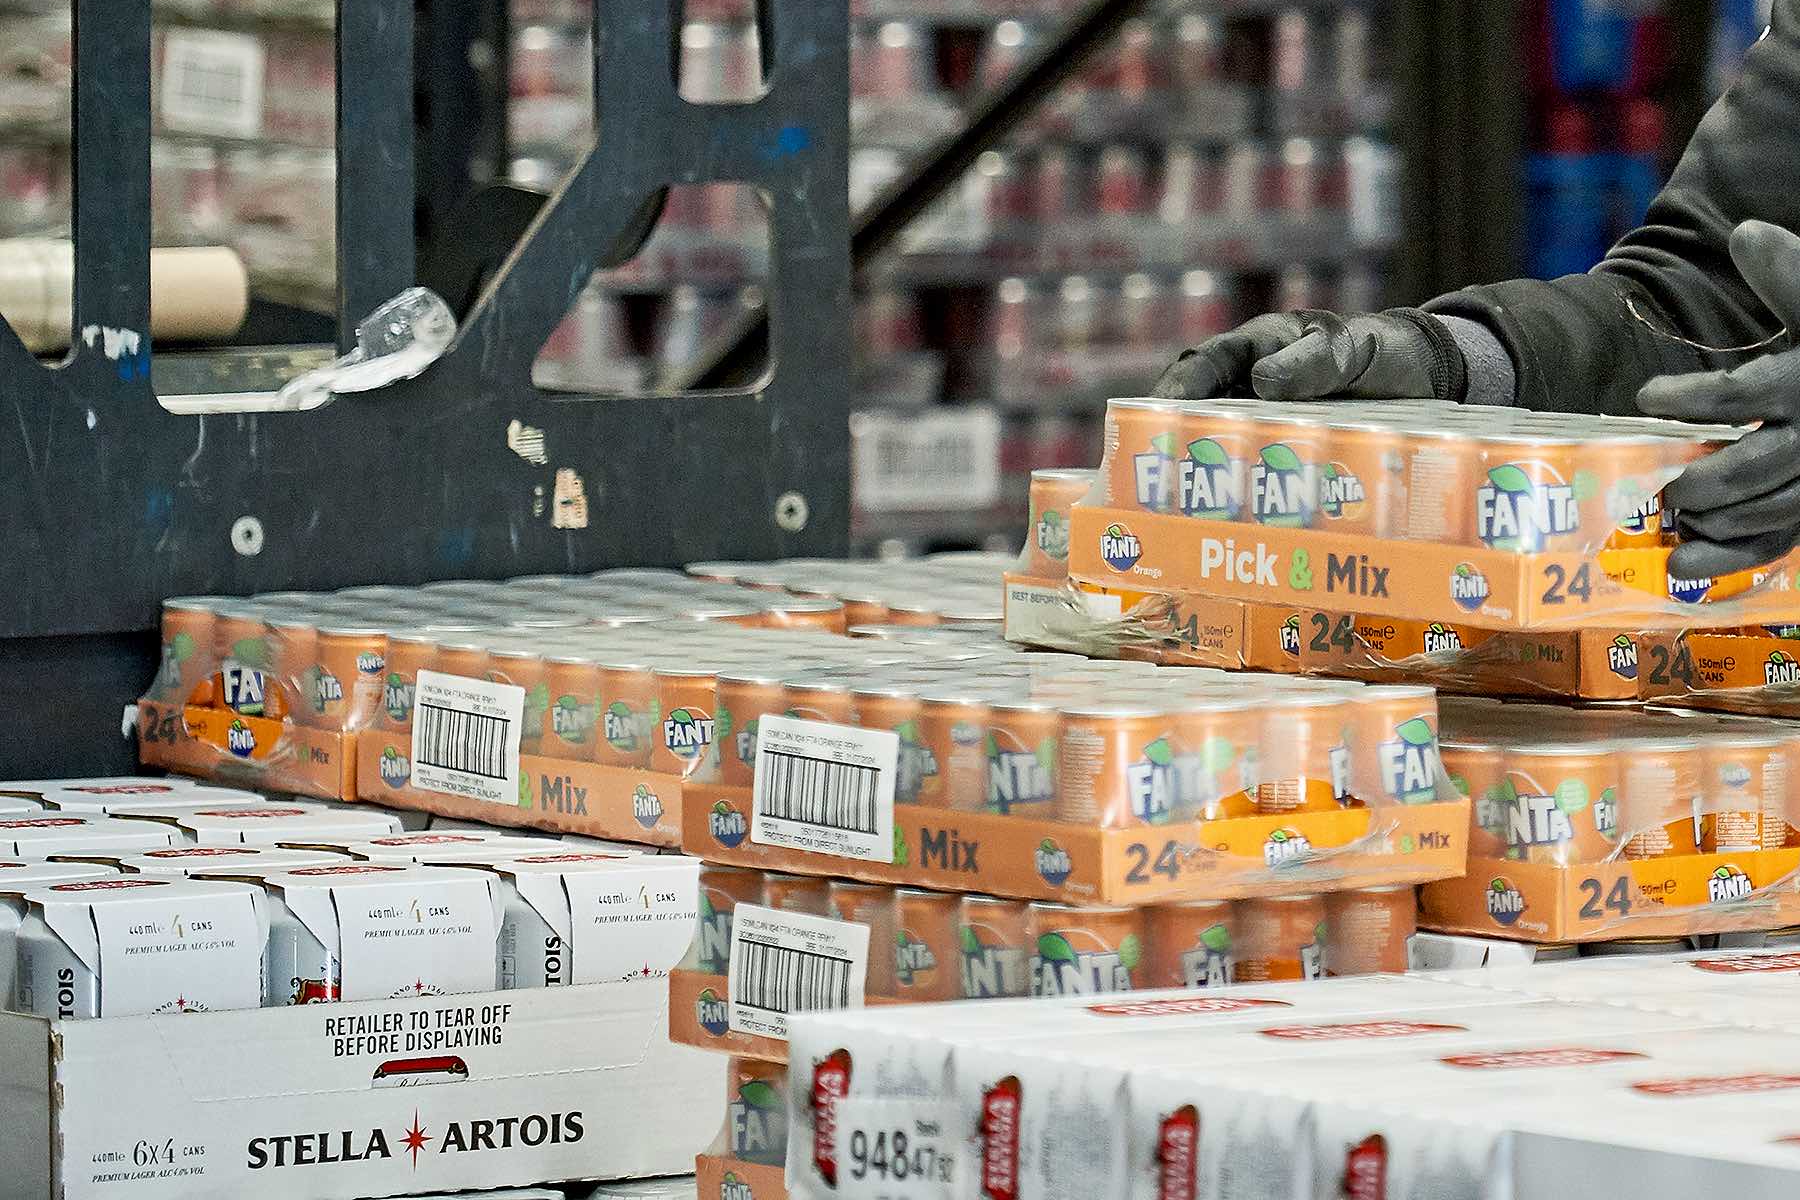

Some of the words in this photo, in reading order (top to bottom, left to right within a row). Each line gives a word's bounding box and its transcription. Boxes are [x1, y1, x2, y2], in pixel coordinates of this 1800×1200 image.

[1251, 463, 1319, 517] FAN
[1477, 484, 1581, 539] FANTA
[1132, 563, 1163, 578] Orange
[1199, 537, 1280, 588] Pick
[1287, 547, 1314, 591] &
[1325, 551, 1391, 599] Mix
[1541, 562, 1592, 605] 24
[1203, 638, 1224, 649] CANS
[1309, 612, 1354, 653] 24
[1423, 631, 1464, 652] FANTA
[1538, 644, 1564, 664] Mix
[1608, 643, 1638, 672] FAN
[1649, 644, 1695, 686] 24
[662, 715, 714, 749] FANT
[540, 774, 589, 817] Mix
[1506, 794, 1574, 846] NTA
[919, 827, 980, 874] Mix
[1418, 832, 1450, 848] Mix
[1124, 840, 1181, 885] 24
[655, 892, 677, 903] CANS
[1578, 875, 1633, 921] 24
[1708, 875, 1753, 903] FANTA
[191, 920, 213, 932] CANS
[428, 906, 450, 917] CANS
[545, 935, 563, 988] TOIS
[1031, 951, 1135, 998] FANTA
[57, 967, 75, 1021] TOIS
[325, 1012, 404, 1038] RETAILER
[410, 1010, 429, 1031] TO
[435, 1007, 475, 1030] TEAR
[481, 1004, 512, 1026] OFF
[334, 1033, 400, 1058] BEFORE
[405, 1025, 502, 1052] DISPLAYING
[183, 1145, 206, 1158] CANS
[247, 1128, 392, 1170] STELLA
[439, 1111, 585, 1154] ARTOIS
[92, 1171, 130, 1183] PREMIUM
[130, 1170, 156, 1181] LAGER
